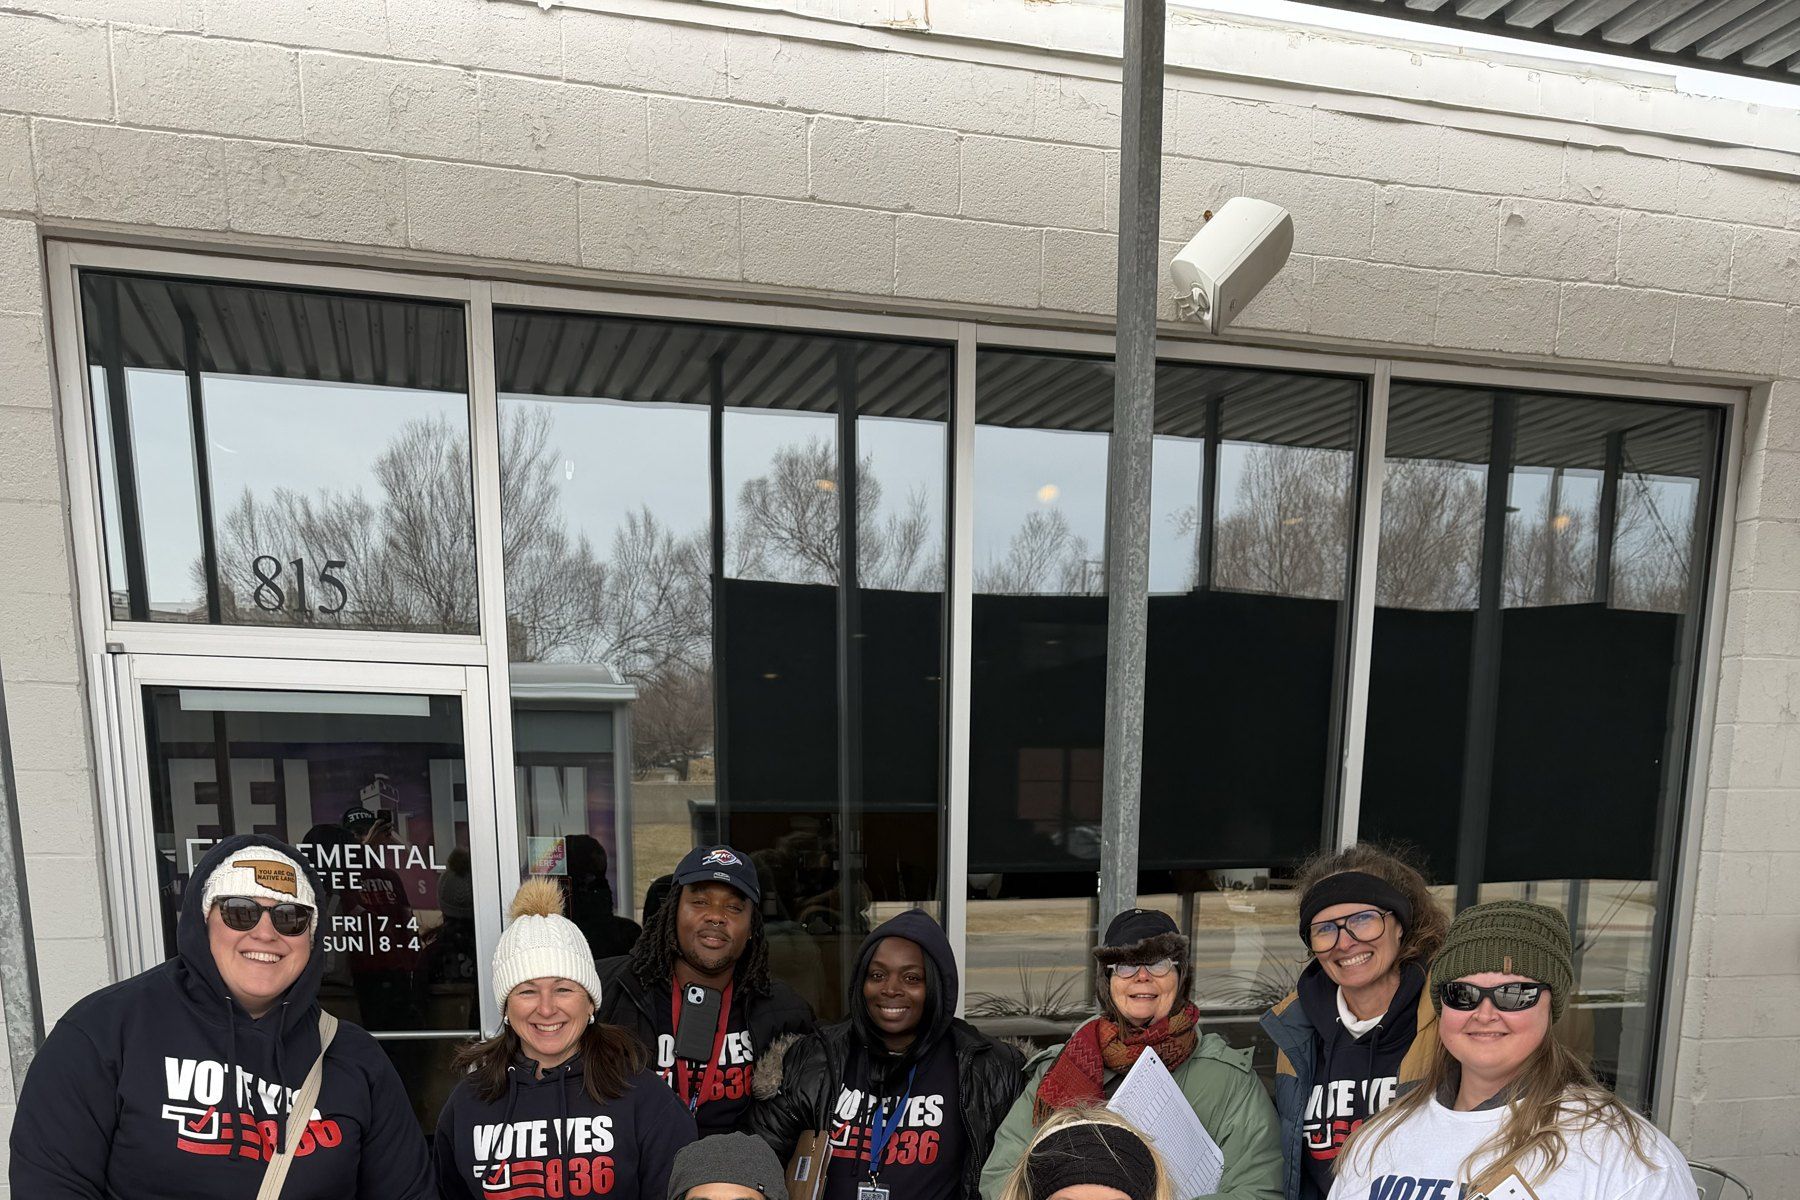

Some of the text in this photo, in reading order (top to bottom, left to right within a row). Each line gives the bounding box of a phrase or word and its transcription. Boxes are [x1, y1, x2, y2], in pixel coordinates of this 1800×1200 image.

[253, 555, 347, 613] 815
[296, 843, 447, 870] EMENTAL
[257, 874, 280, 882] NATIVE
[332, 916, 362, 932] FRI
[377, 916, 389, 932] 7
[406, 916, 419, 932] 4
[323, 935, 364, 952] SUN
[379, 935, 391, 952] 8
[408, 936, 421, 952] 4
[1361, 1076, 1397, 1115] YE
[473, 1115, 615, 1161] VOTE YES
[546, 1155, 615, 1199] 836
